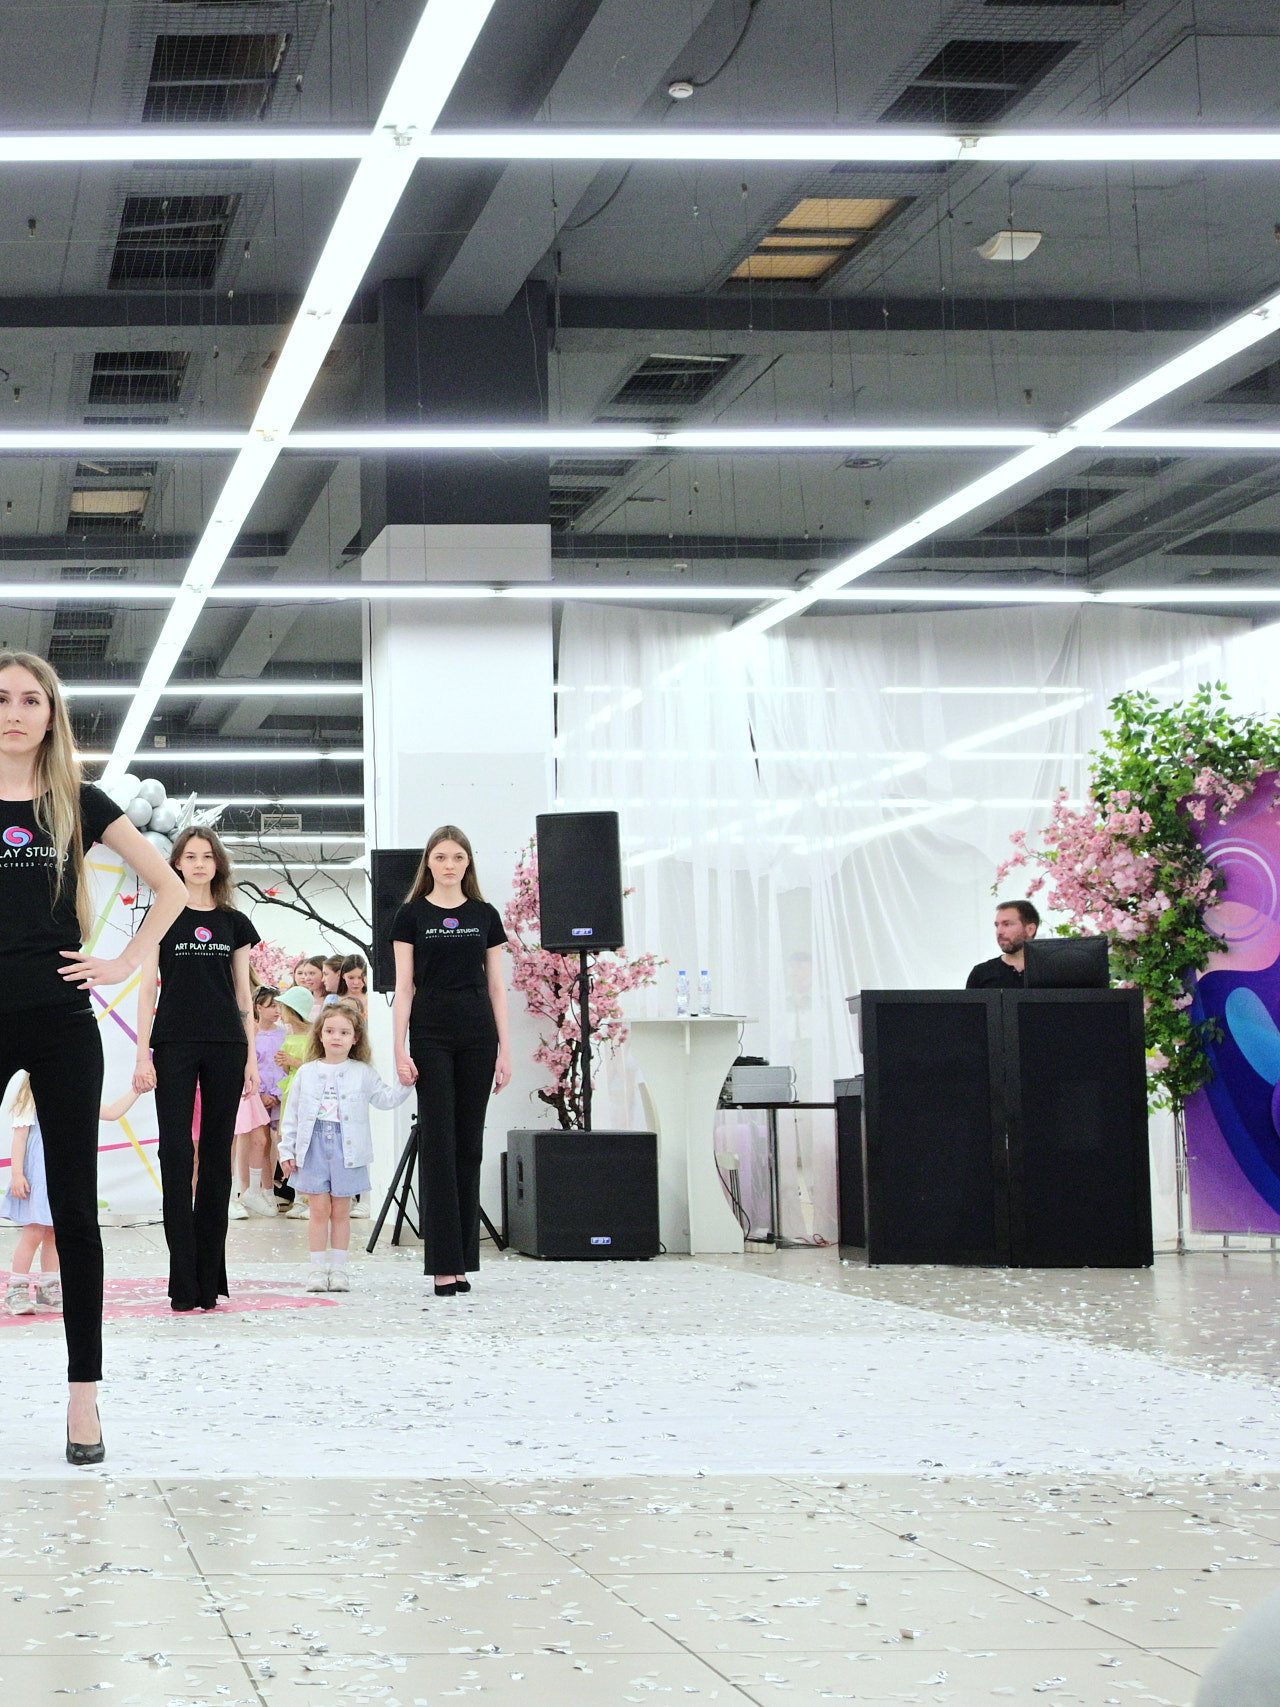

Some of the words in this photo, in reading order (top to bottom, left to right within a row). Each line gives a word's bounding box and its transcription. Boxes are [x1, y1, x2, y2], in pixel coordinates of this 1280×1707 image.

[25, 846, 69, 862] STUDO
[175, 943, 188, 951] ART
[189, 943, 206, 951] PLAY
[208, 943, 231, 952] STUDIO
